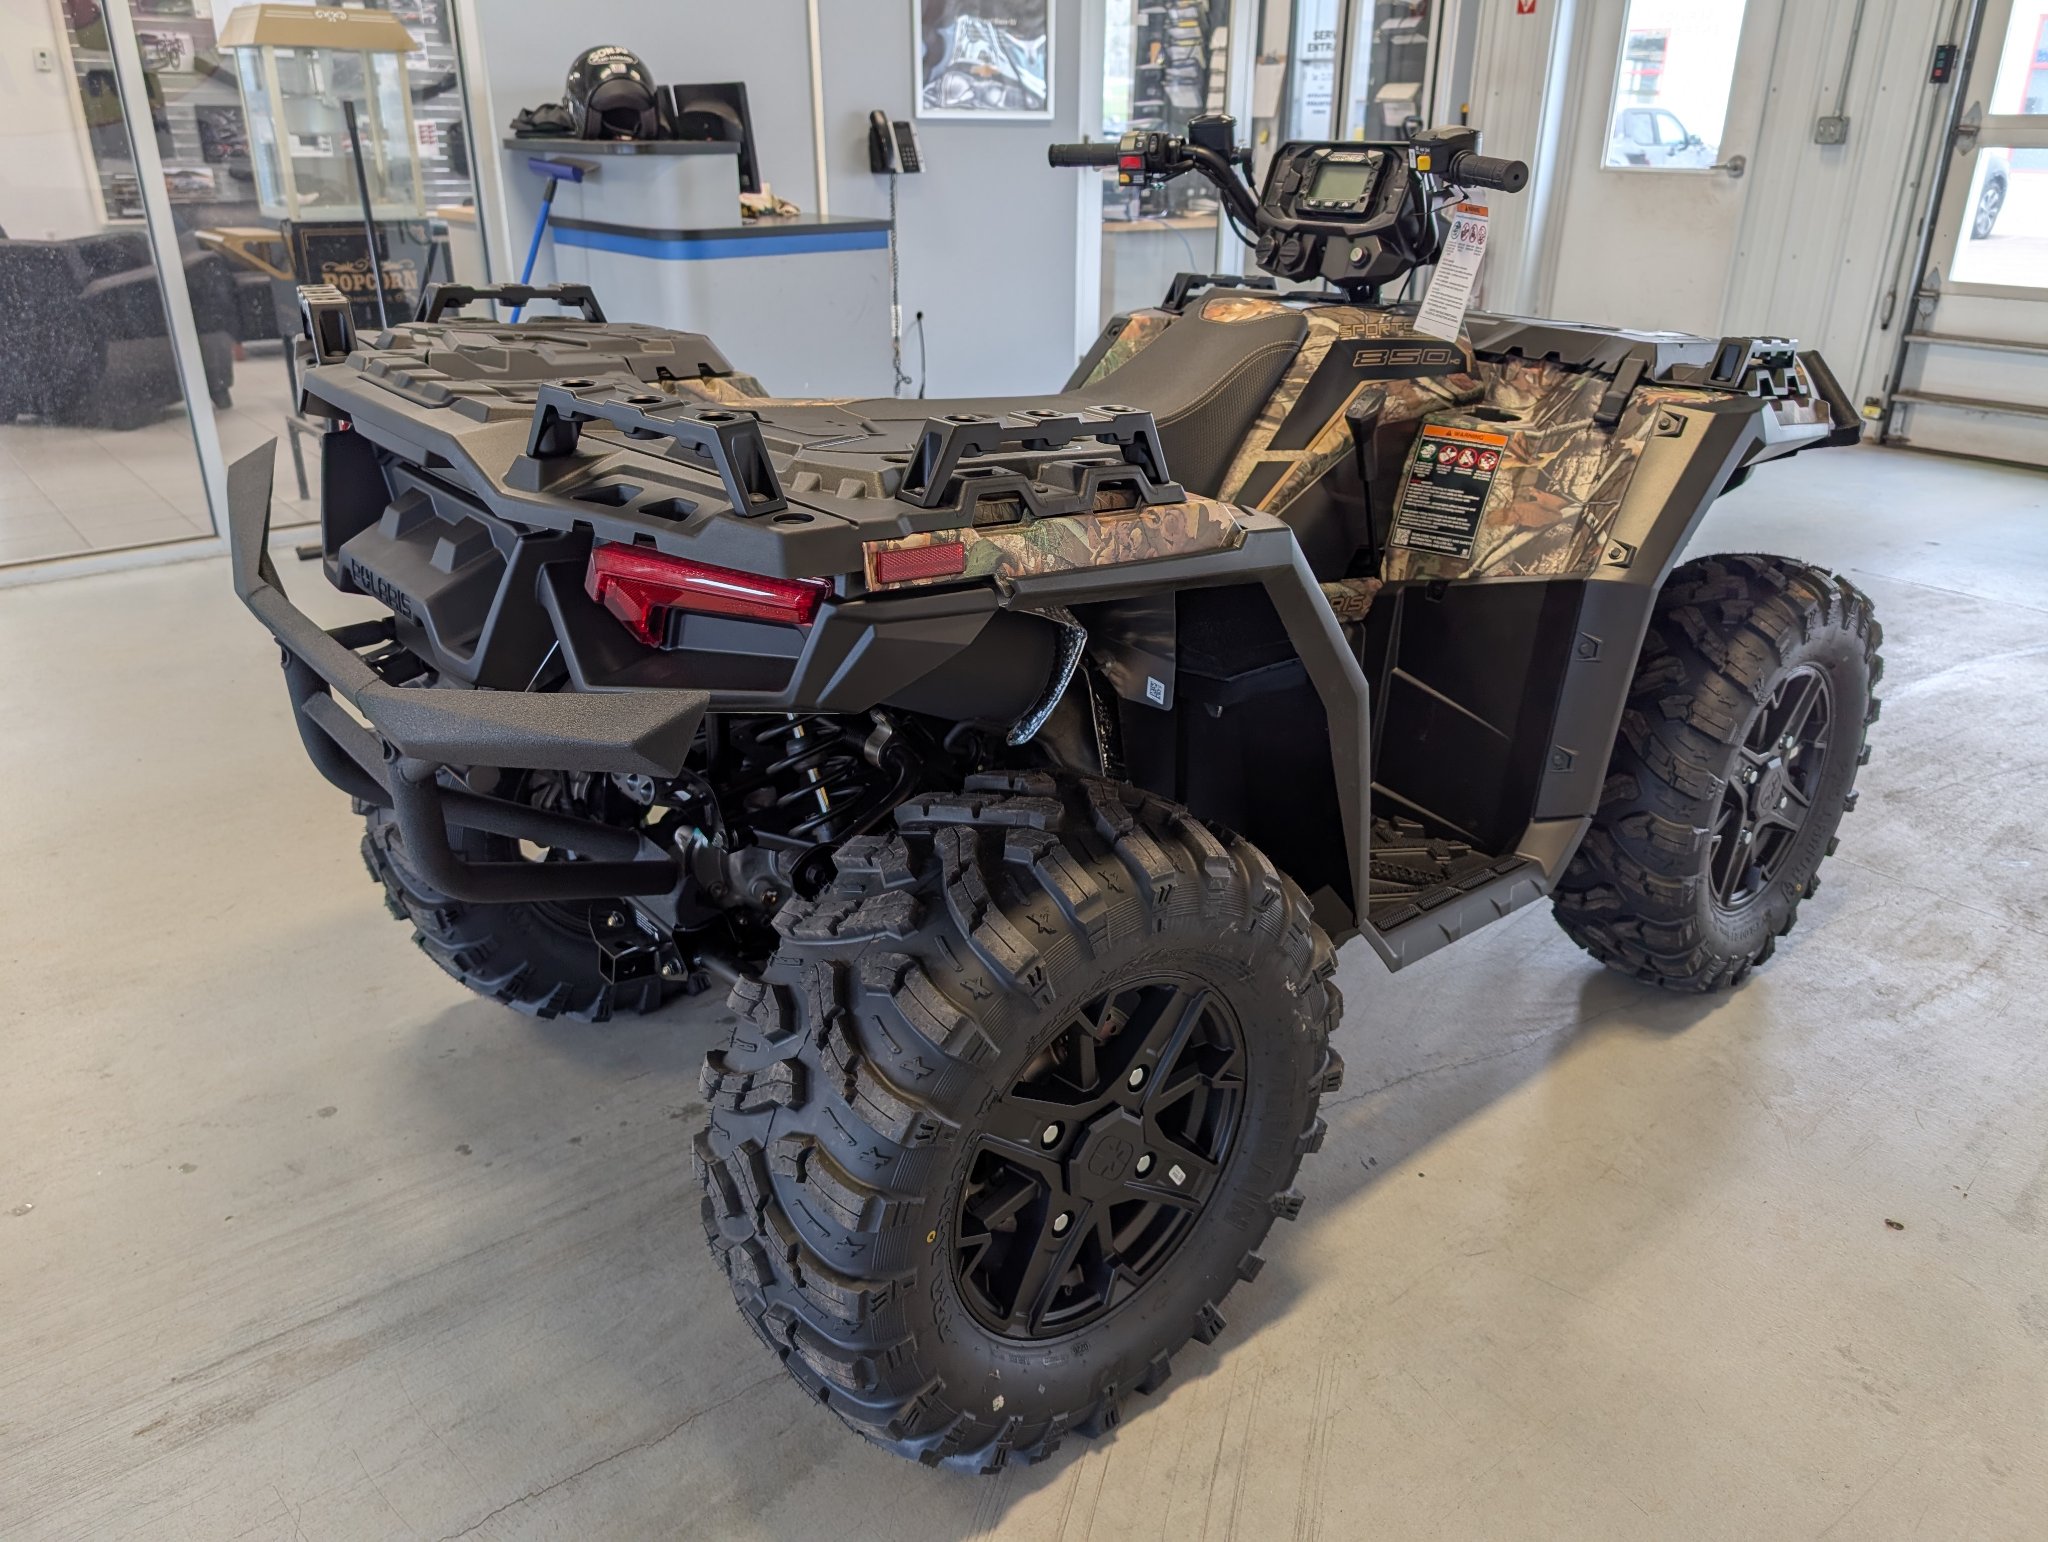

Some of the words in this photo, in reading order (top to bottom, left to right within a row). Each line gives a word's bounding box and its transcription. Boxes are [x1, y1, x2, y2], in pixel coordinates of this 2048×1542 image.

[1339, 322, 1416, 338] SPORTS
[1353, 348, 1451, 367] 850
[351, 558, 413, 620] POLARIS
